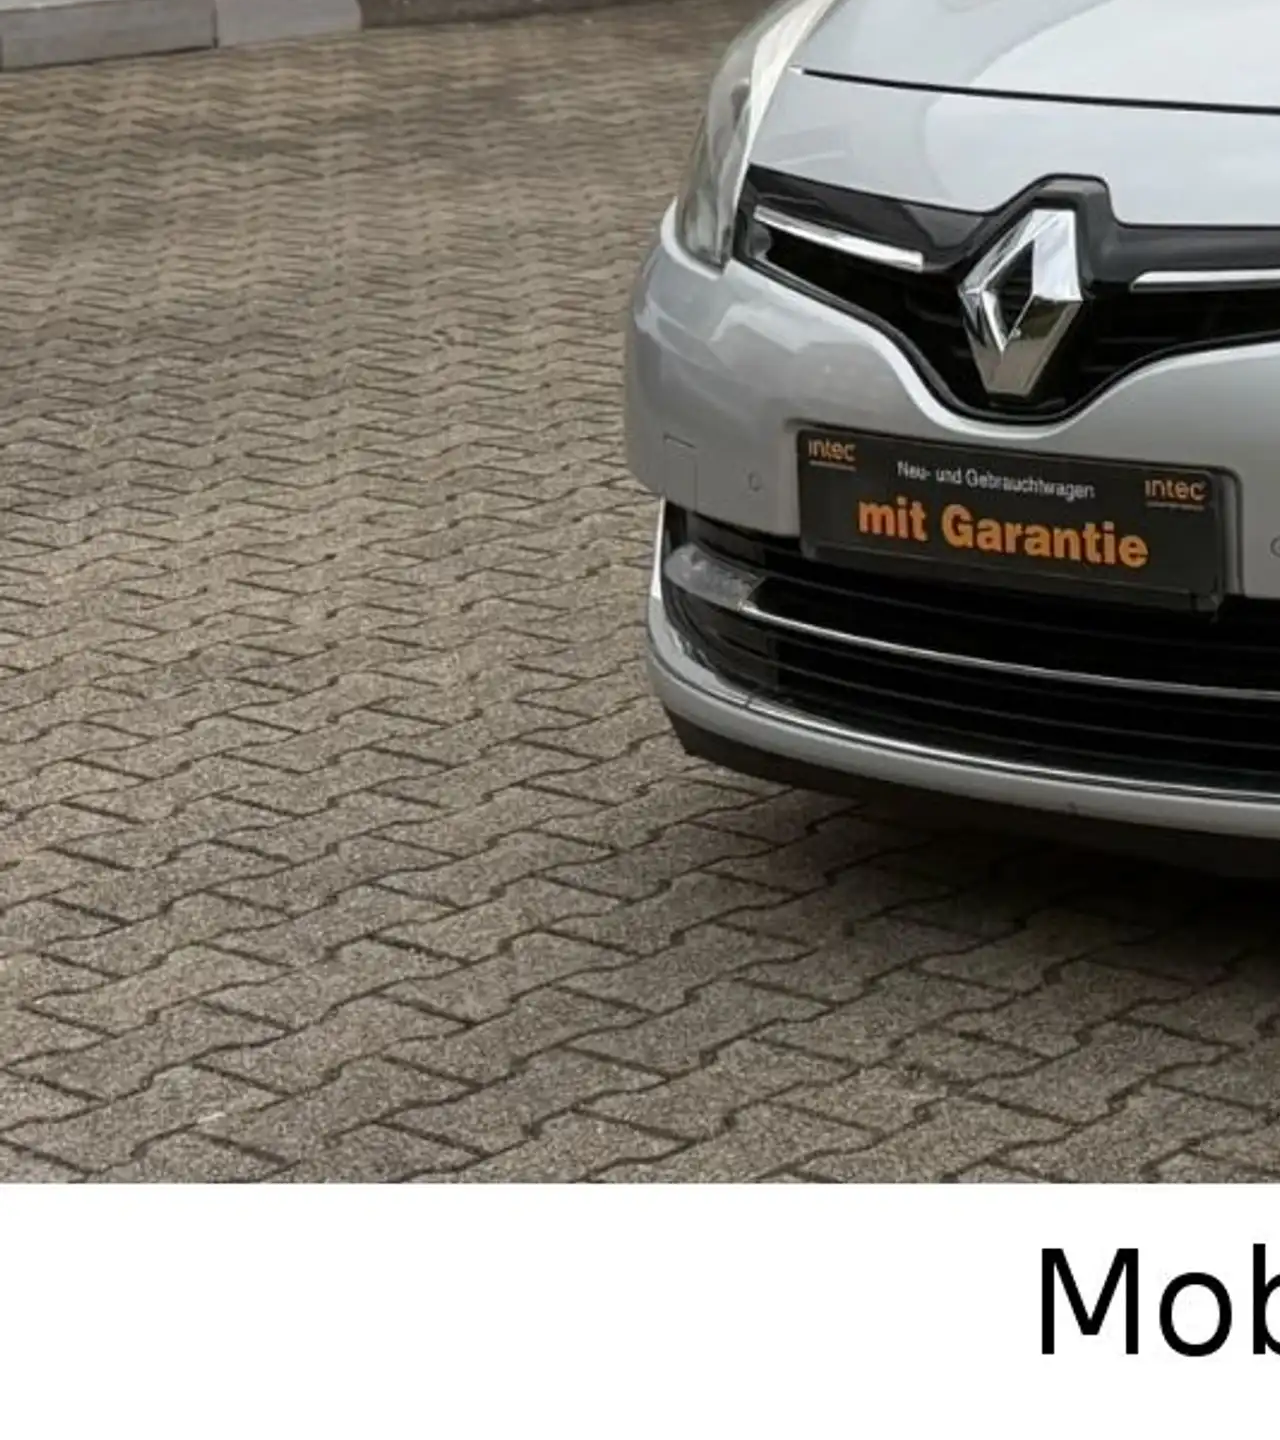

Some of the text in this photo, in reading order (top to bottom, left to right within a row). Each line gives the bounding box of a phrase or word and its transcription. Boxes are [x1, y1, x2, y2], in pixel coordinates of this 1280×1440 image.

[897, 460, 1095, 503] Neu- und Gebrauchtwagen
[858, 494, 1149, 569] mit Garantie
